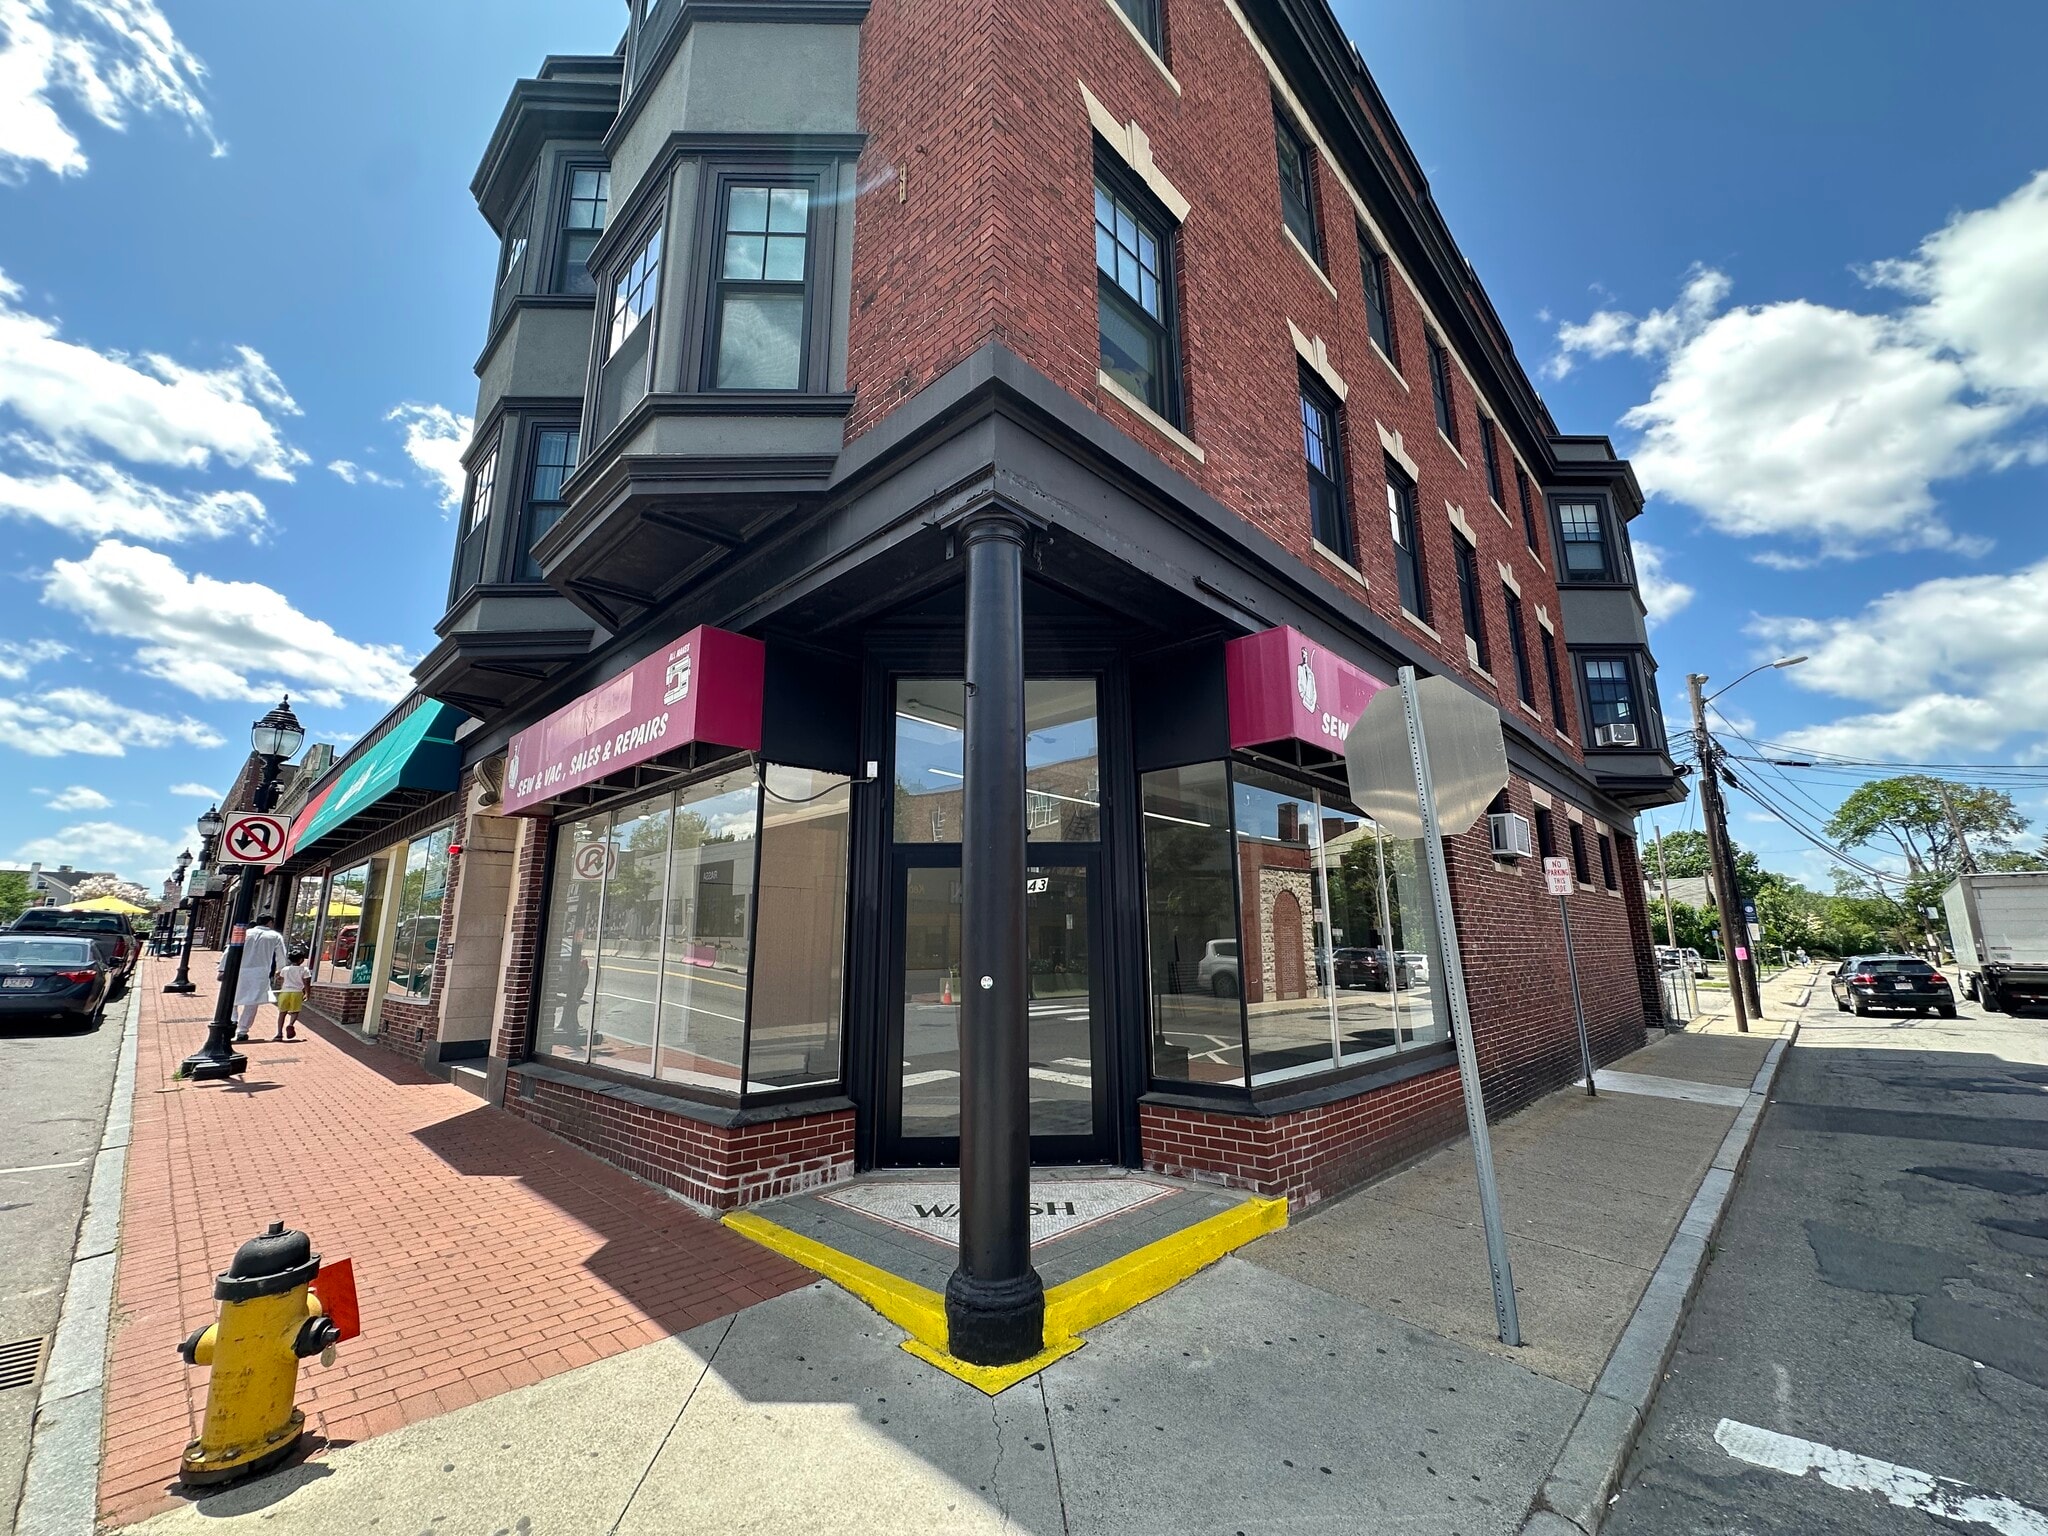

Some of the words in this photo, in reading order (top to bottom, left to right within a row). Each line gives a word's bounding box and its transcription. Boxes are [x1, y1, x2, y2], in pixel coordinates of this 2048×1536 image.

[1321, 712, 1350, 741] SEW
[516, 774, 536, 798] SEW
[534, 771, 543, 791] &
[569, 744, 602, 776] SALES
[601, 739, 612, 762] &
[613, 712, 669, 757] REPAIRS
[1028, 879, 1047, 892] 43
[1553, 877, 1566, 885] THIS
[1554, 885, 1567, 893] SIDE
